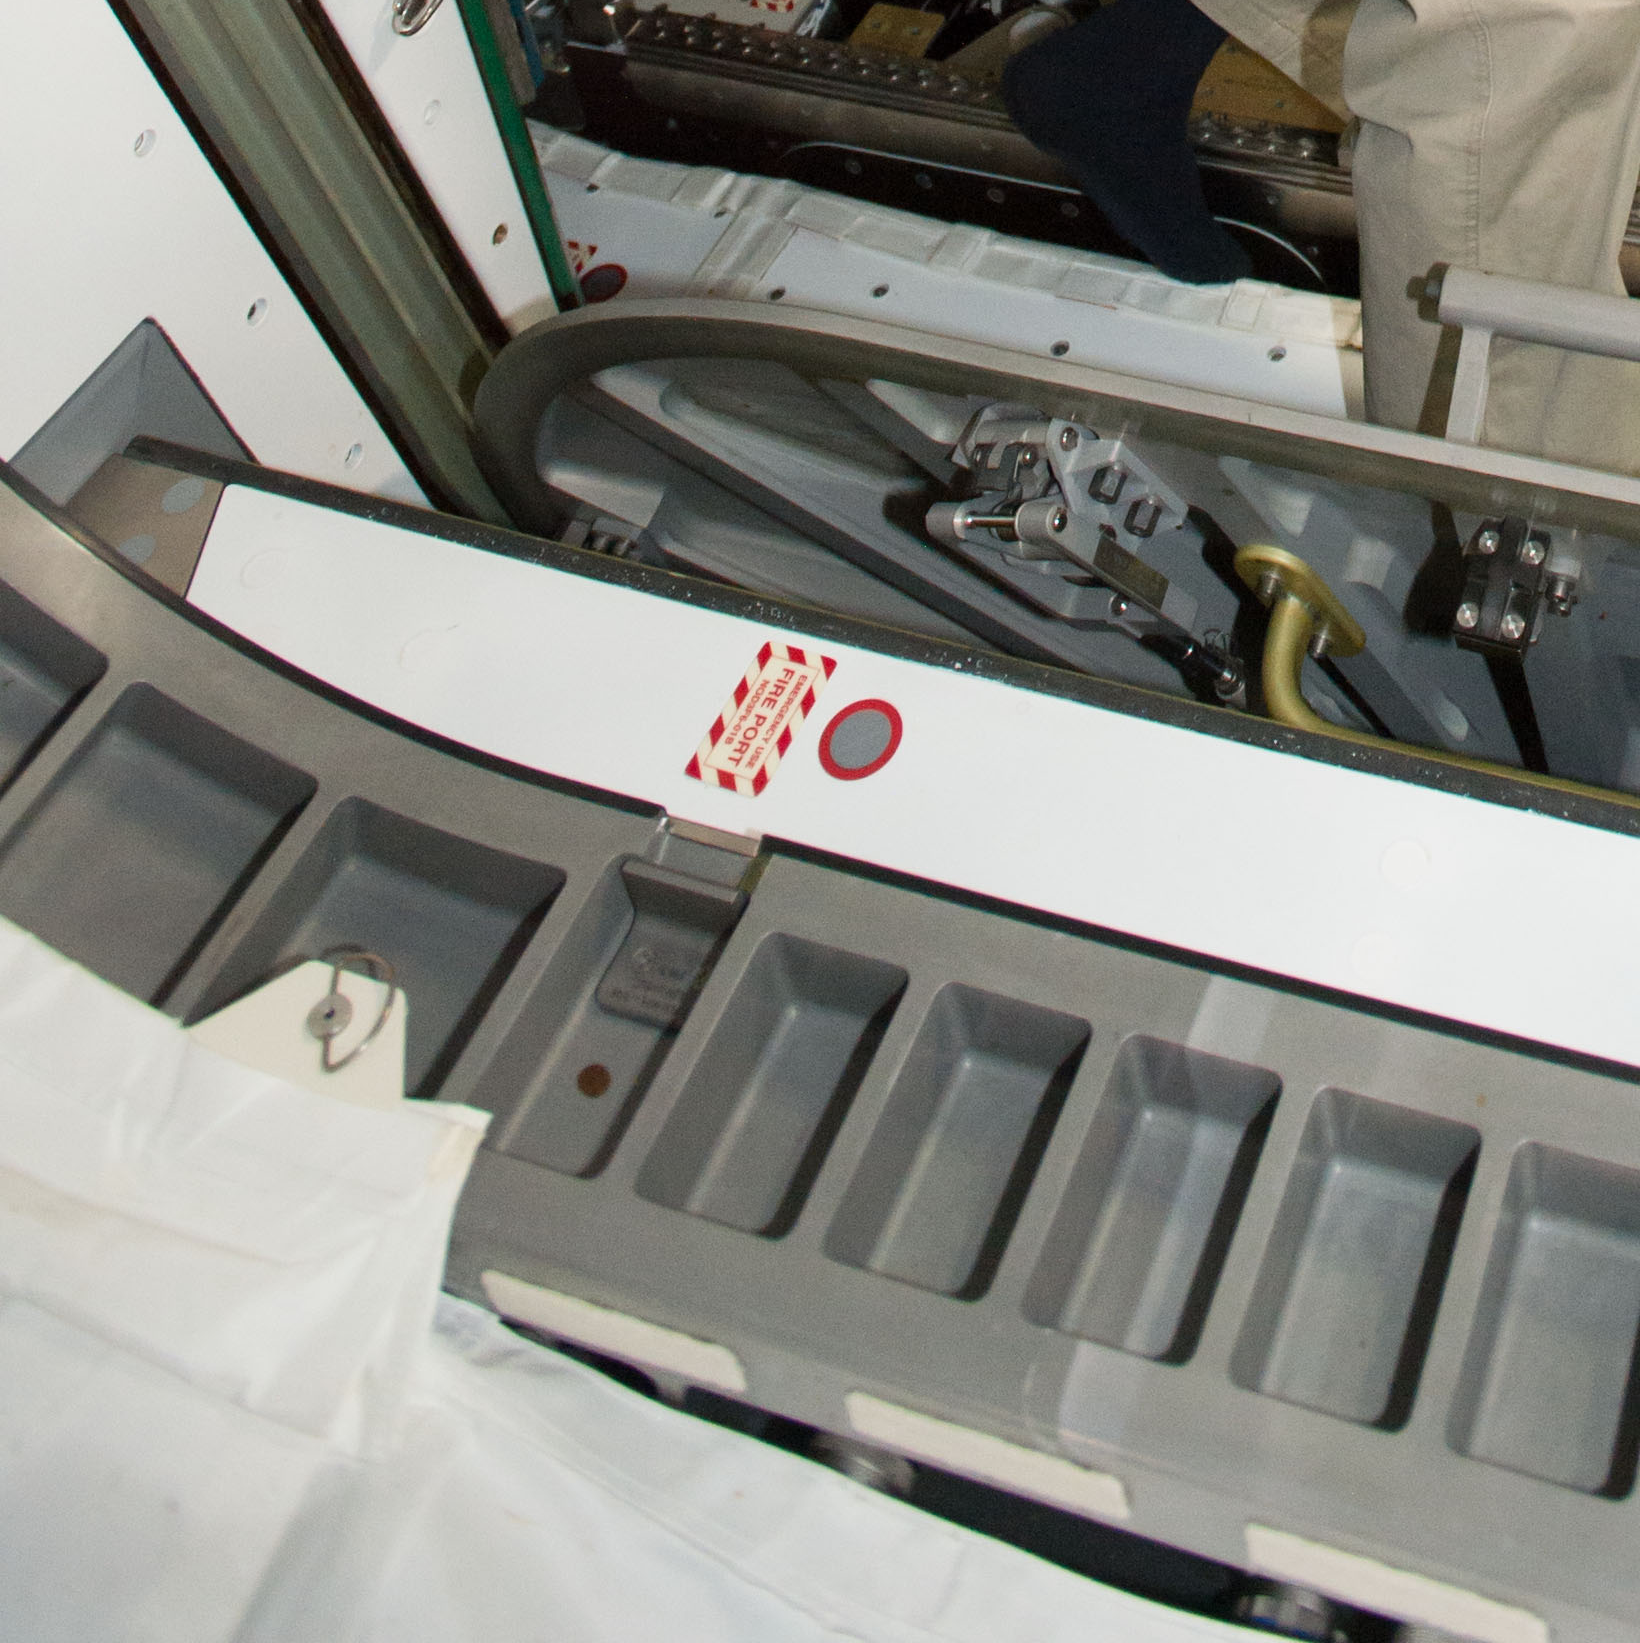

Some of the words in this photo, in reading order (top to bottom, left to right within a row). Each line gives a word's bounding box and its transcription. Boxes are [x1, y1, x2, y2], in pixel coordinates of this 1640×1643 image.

[724, 679, 770, 745] NOD3F6-01B
[761, 667, 795, 710] FIRE
[762, 674, 808, 744] EMERGENCY
[728, 713, 767, 767] PORT
[746, 747, 765, 769] USE
